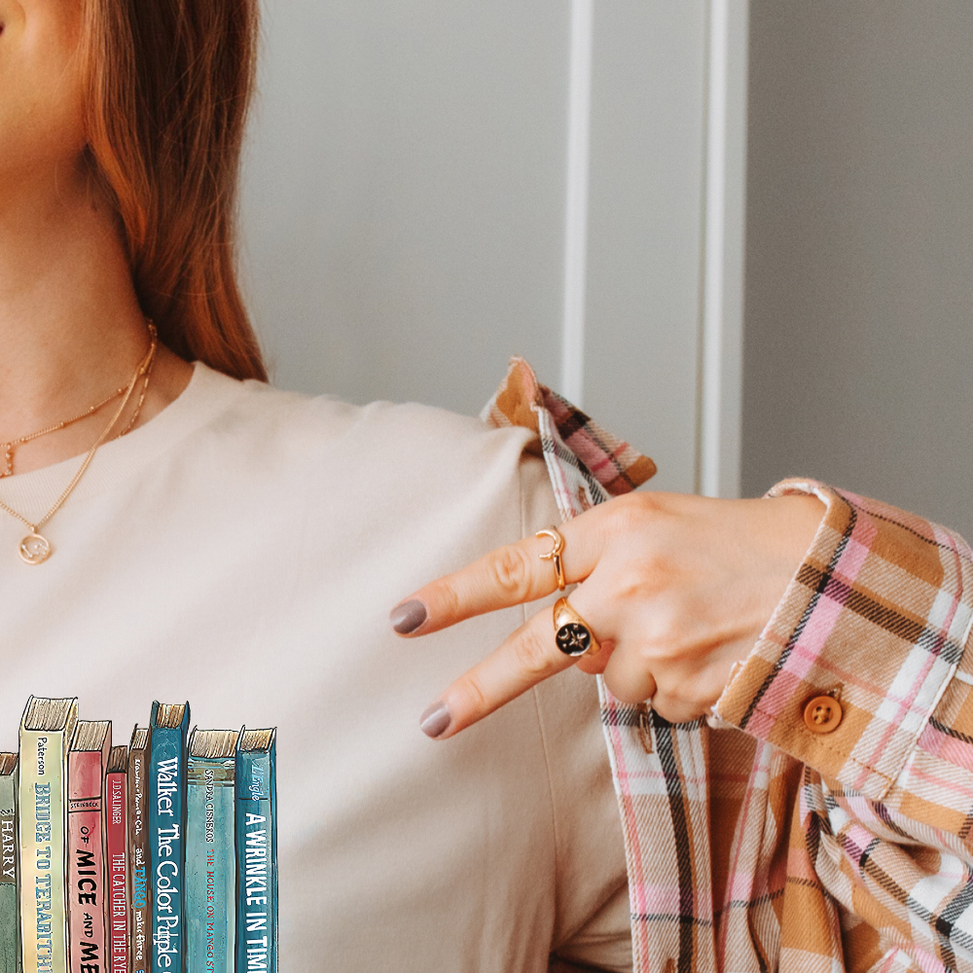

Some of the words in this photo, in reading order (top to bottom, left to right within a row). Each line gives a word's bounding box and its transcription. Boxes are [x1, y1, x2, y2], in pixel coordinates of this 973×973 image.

[37, 737, 47, 776] Paterson
[157, 758, 179, 816] Walker
[204, 769, 215, 802] SANDRA
[35, 782, 51, 843] BRIDGE
[245, 812, 267, 826] A
[1, 819, 15, 879] HARRY
[80, 826, 90, 845] OF
[157, 823, 180, 857] The
[36, 846, 51, 870] TO
[112, 852, 125, 872] THE
[245, 829, 267, 906] WRINKLE
[76, 849, 97, 907] MICE
[134, 867, 148, 909] TANGO
[157, 860, 179, 914] Color
[206, 871, 215, 902] HOUSE
[112, 874, 126, 918] CATCHER
[206, 905, 215, 919] ON
[83, 912, 94, 938] AND
[113, 920, 126, 931] IN
[246, 912, 267, 932] IN
[113, 933, 126, 954] THE
[153, 915, 179, 968] Purple
[206, 922, 215, 958] MANGO
